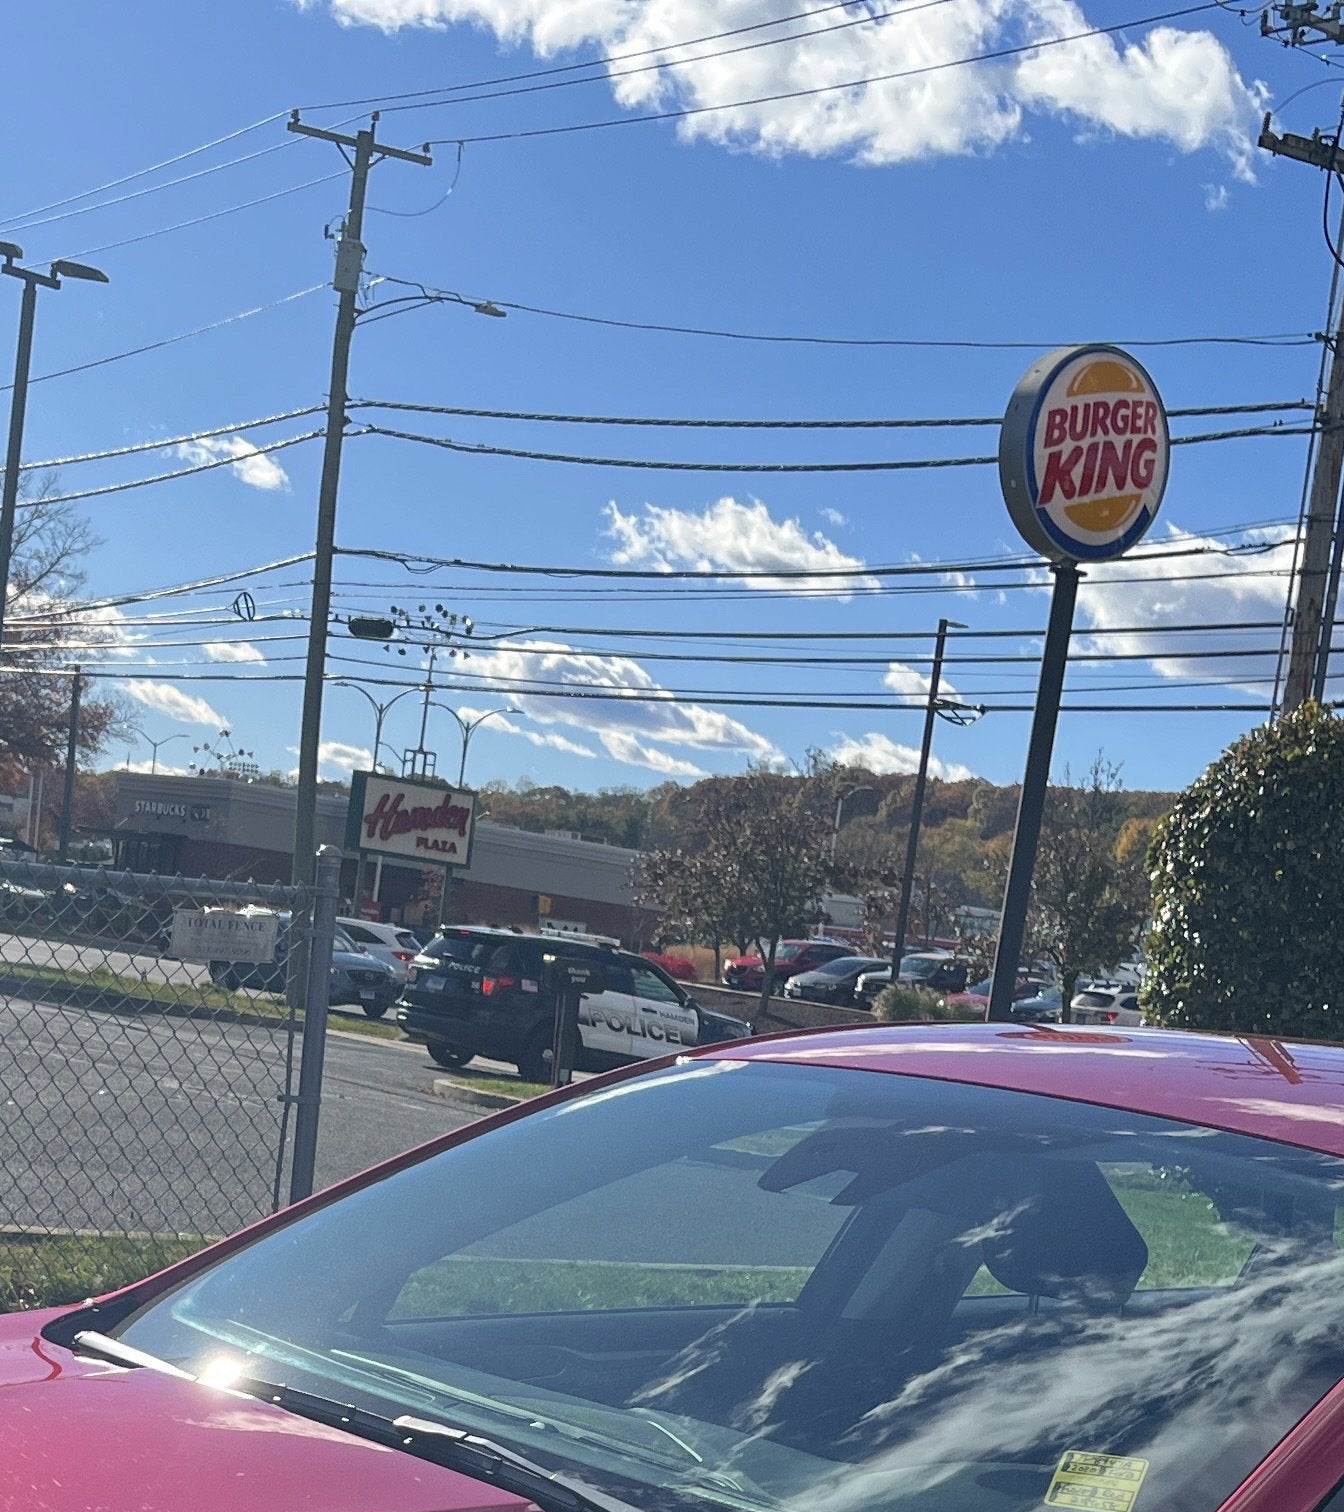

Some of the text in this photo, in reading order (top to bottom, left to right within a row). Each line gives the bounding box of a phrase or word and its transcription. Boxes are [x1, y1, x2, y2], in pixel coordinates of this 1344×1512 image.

[1043, 399, 1158, 449] BURGER
[1038, 437, 1158, 506] KING
[135, 800, 186, 817] STARBUCKS
[364, 793, 470, 841] Hamden
[416, 836, 457, 854] PLAZA
[187, 917, 266, 931] TOTAL FENCE
[449, 961, 481, 974] POLICE
[586, 1007, 682, 1045] POLICE
[659, 1010, 696, 1026] HAMDEN
